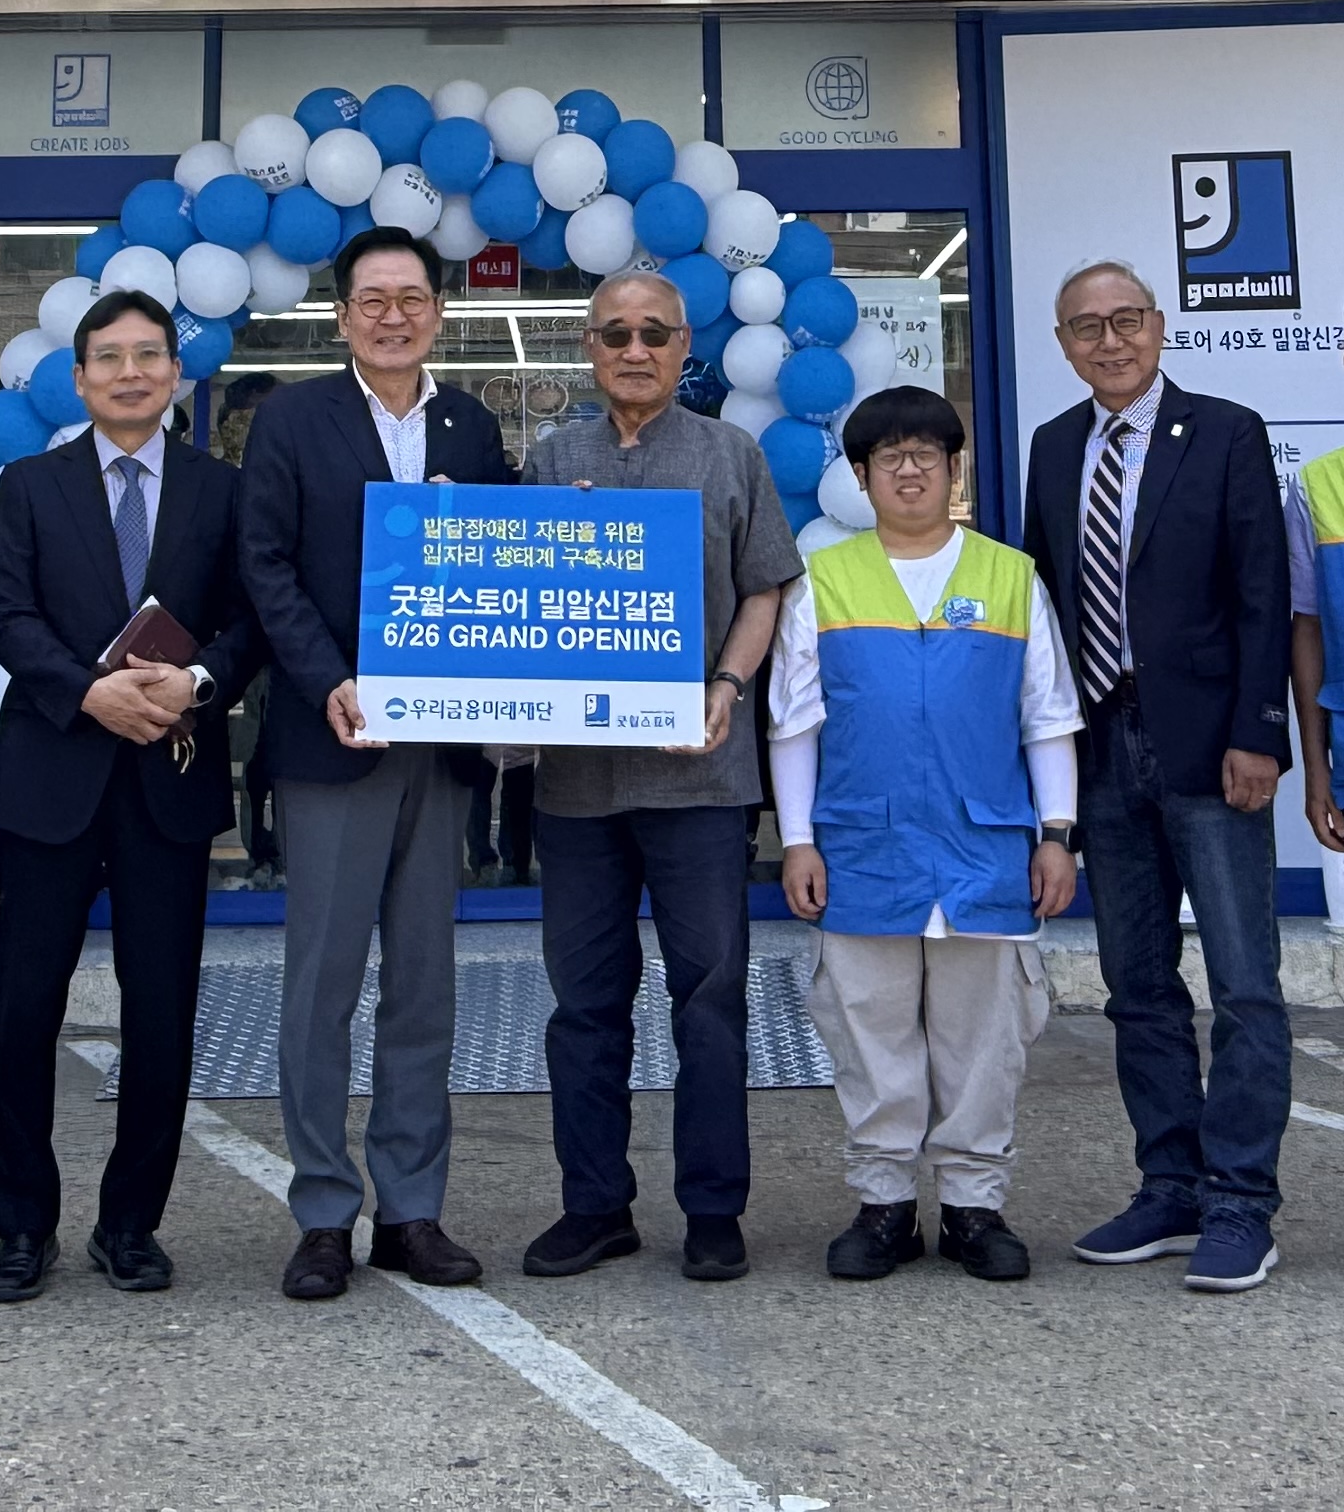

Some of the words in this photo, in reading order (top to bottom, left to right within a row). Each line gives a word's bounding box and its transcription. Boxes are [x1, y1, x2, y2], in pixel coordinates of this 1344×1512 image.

[30, 137, 89, 153] CREATE
[779, 131, 828, 145] GOOD
[1187, 275, 1293, 308] goodwill
[1219, 328, 1267, 352] 49호
[389, 585, 528, 620] 굿윌스토어
[538, 589, 676, 624] 밀알신길점
[383, 620, 440, 648] 6/26
[448, 624, 548, 650] GRAND
[557, 626, 682, 652] OPENING
[409, 697, 554, 722] 우리금융미래재단
